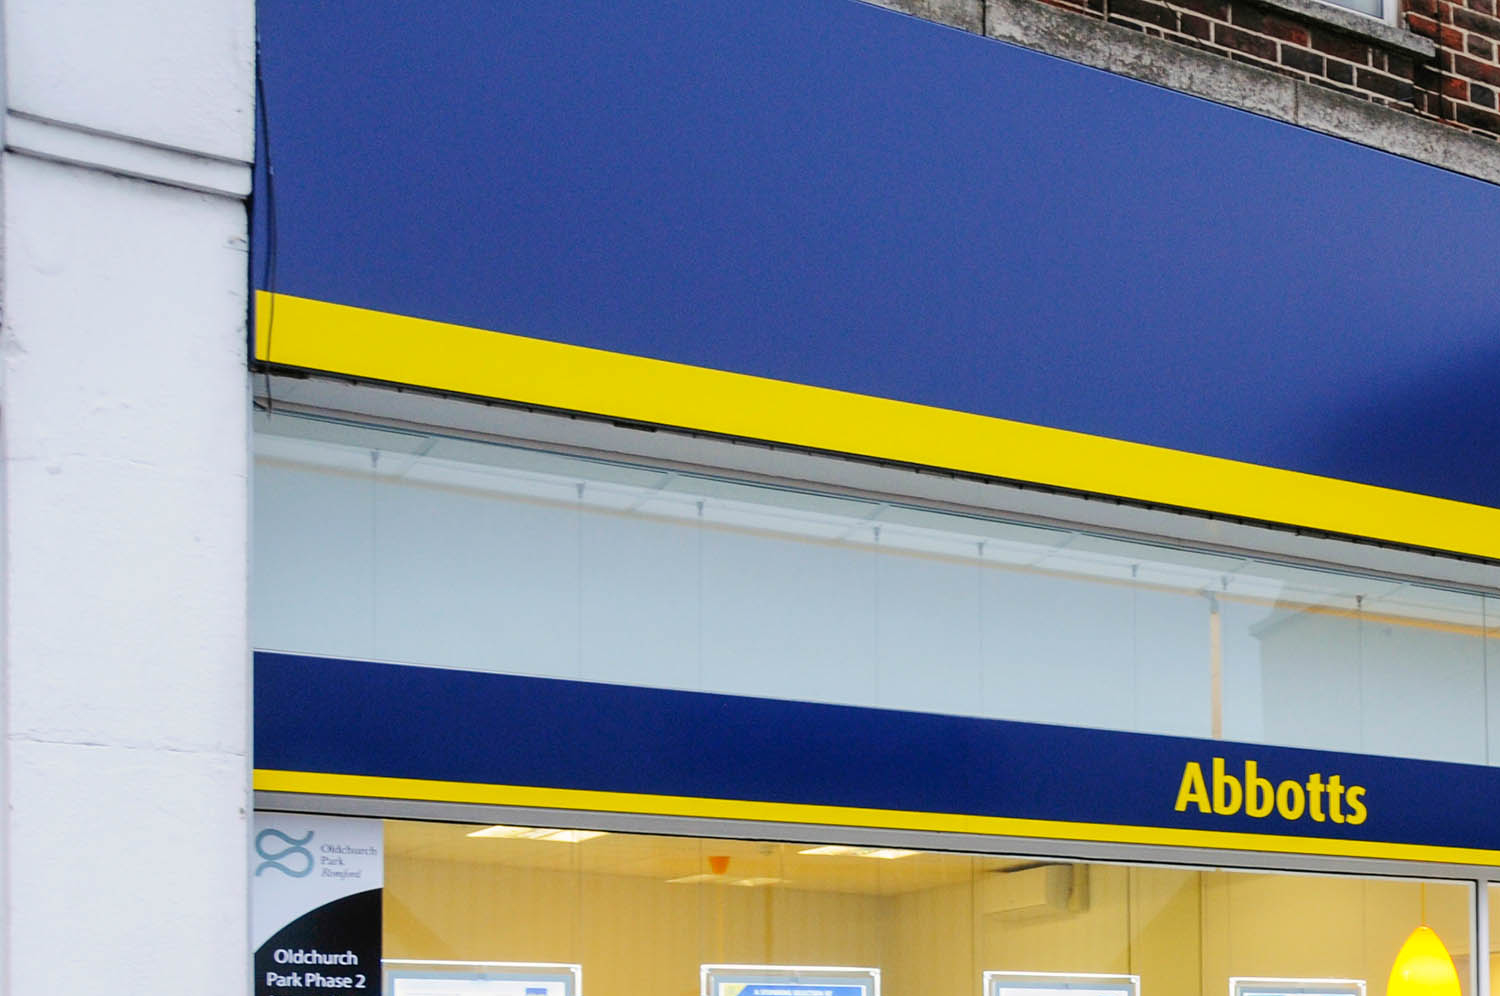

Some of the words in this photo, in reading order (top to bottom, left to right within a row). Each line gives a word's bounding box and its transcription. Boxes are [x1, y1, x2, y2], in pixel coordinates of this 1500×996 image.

[1174, 757, 1367, 824] Abbotts
[321, 844, 377, 856] Oldchurch
[320, 856, 344, 865] Park
[273, 949, 359, 965] Oldchurch
[266, 972, 303, 987] Park
[304, 972, 353, 988] Phase
[355, 974, 366, 989] 2
